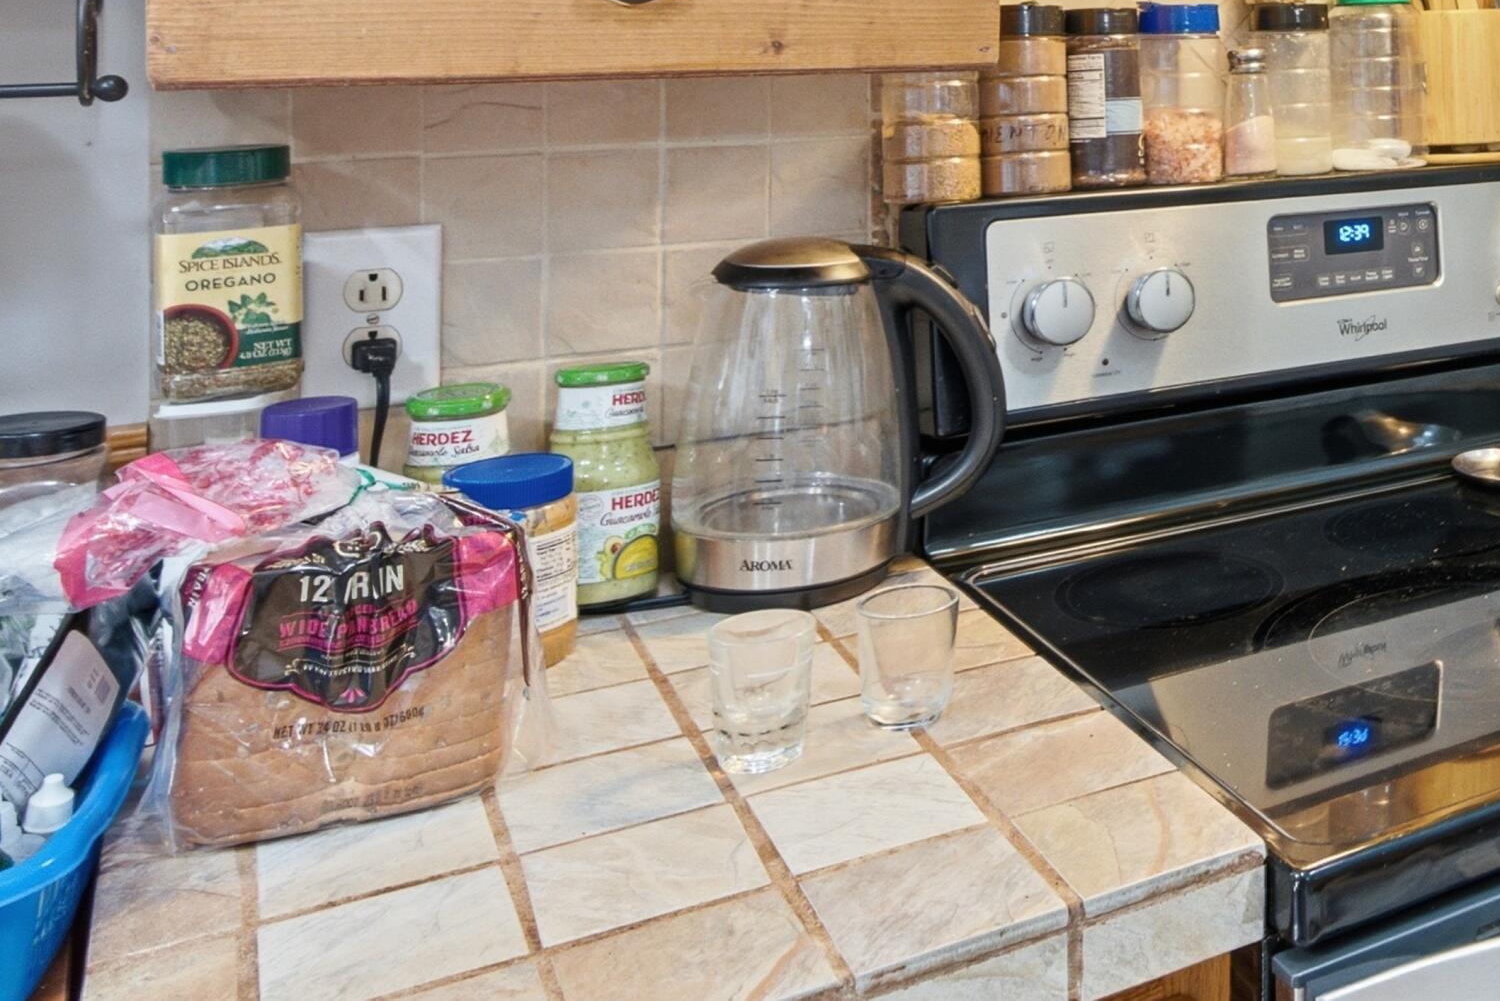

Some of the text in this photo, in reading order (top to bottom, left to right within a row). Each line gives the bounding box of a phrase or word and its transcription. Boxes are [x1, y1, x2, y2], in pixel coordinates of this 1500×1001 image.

[1340, 223, 1370, 241] 12:39
[179, 252, 281, 274] SPICE ISLANDS
[184, 272, 277, 292] OREGANO
[1339, 317, 1387, 335] Whirlpool
[412, 430, 473, 446] HERDEZ
[739, 559, 792, 572] AROMA
[300, 574, 328, 603] 12
[279, 616, 328, 638] WIDE
[273, 725, 294, 740] NET
[332, 720, 346, 733] OZ
